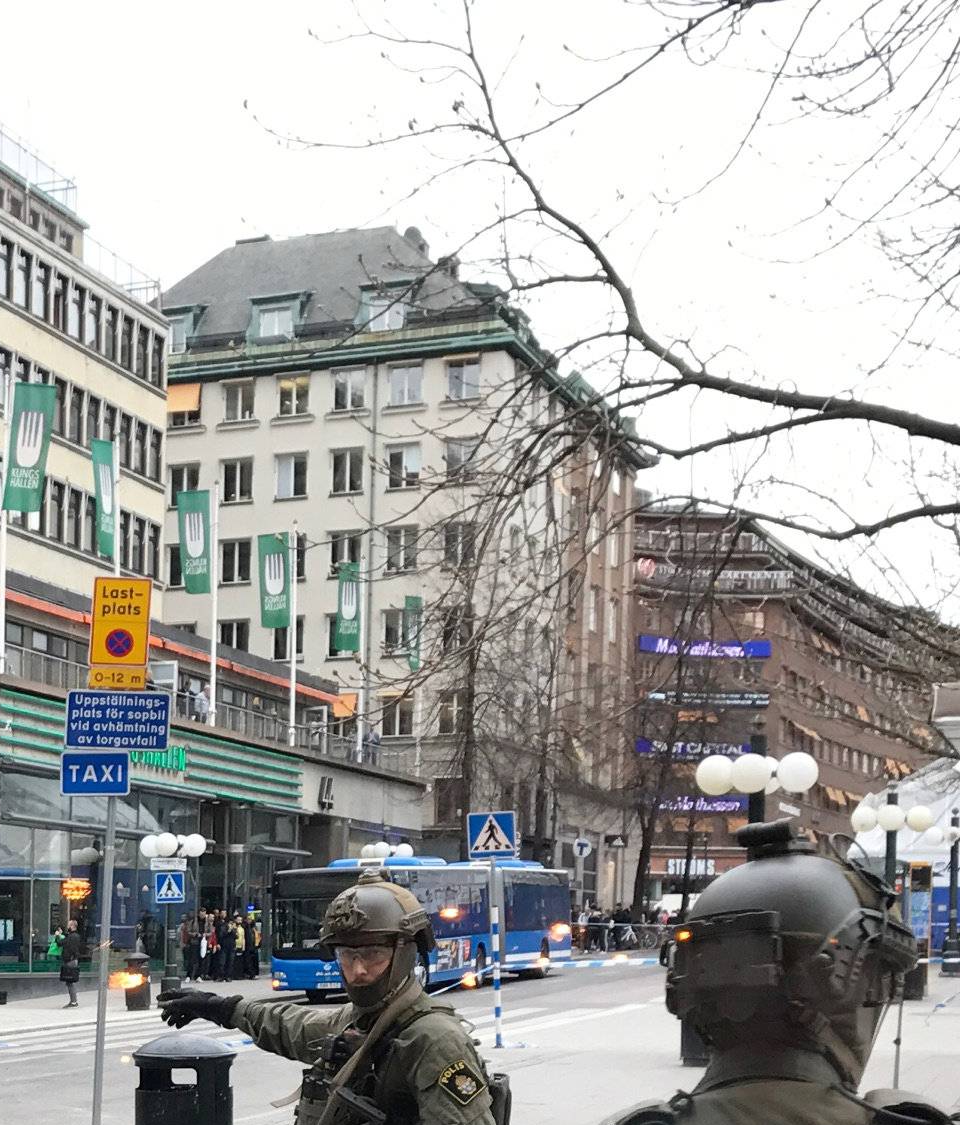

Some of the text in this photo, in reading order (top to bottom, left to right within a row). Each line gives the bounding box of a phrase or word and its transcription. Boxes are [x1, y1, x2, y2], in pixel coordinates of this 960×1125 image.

[11, 468, 40, 479] KUNGS
[10, 478, 39, 489] HALLEN
[102, 585, 144, 600] Last-
[102, 602, 142, 617] plats
[94, 672, 124, 683] 0-12
[75, 694, 166, 709] Uppställnings-
[71, 707, 166, 722] plats för sopbil
[70, 720, 166, 736] vid avhämtning
[77, 734, 157, 748] av torgavfall
[68, 764, 123, 783] TAXI
[441, 1062, 465, 1084] POLIS
